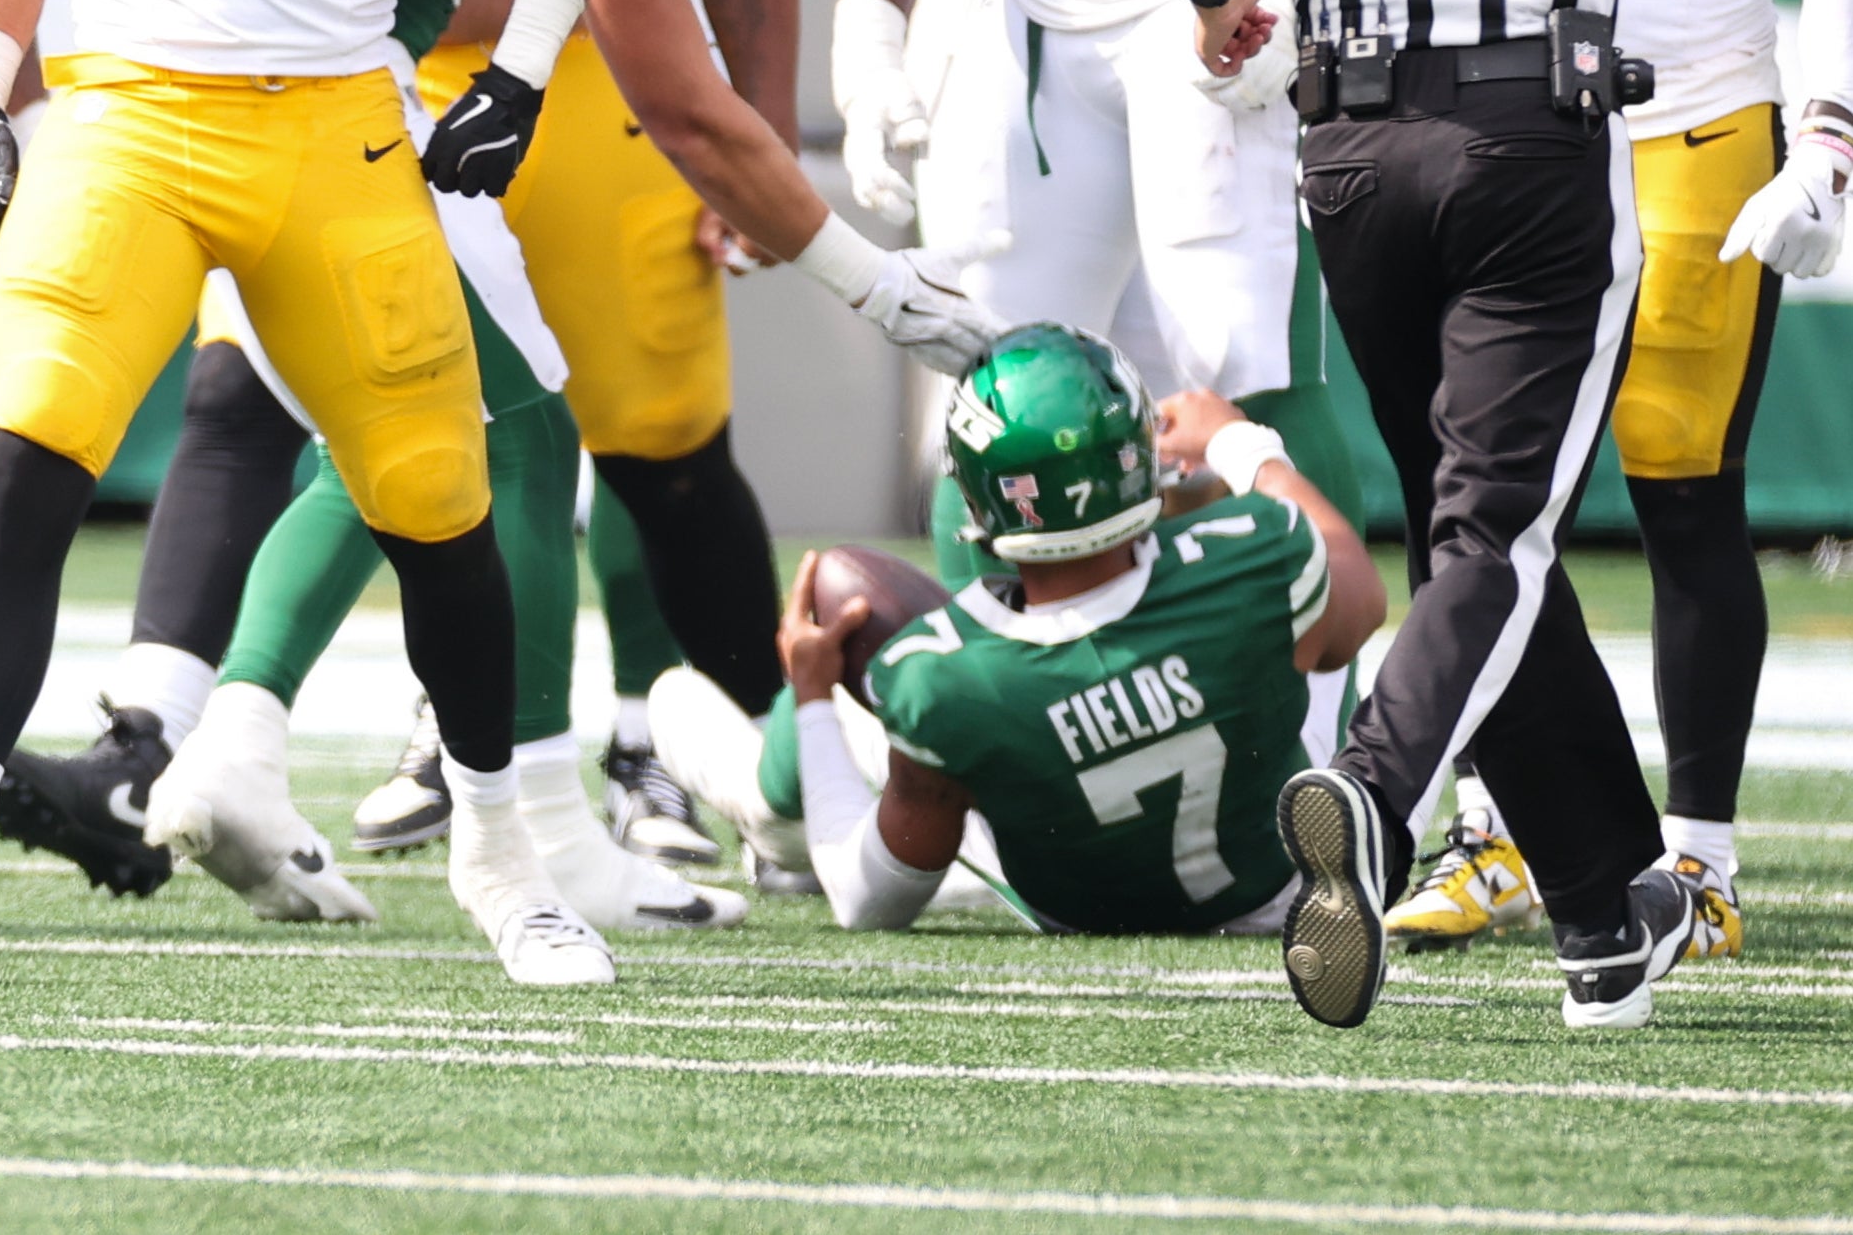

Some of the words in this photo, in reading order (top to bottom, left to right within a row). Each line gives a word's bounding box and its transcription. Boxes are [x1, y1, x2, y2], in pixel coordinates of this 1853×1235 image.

[1064, 479, 1094, 519] 7
[882, 607, 965, 669] 7
[1047, 654, 1205, 765] FIELDS
[1076, 721, 1237, 904] 7
